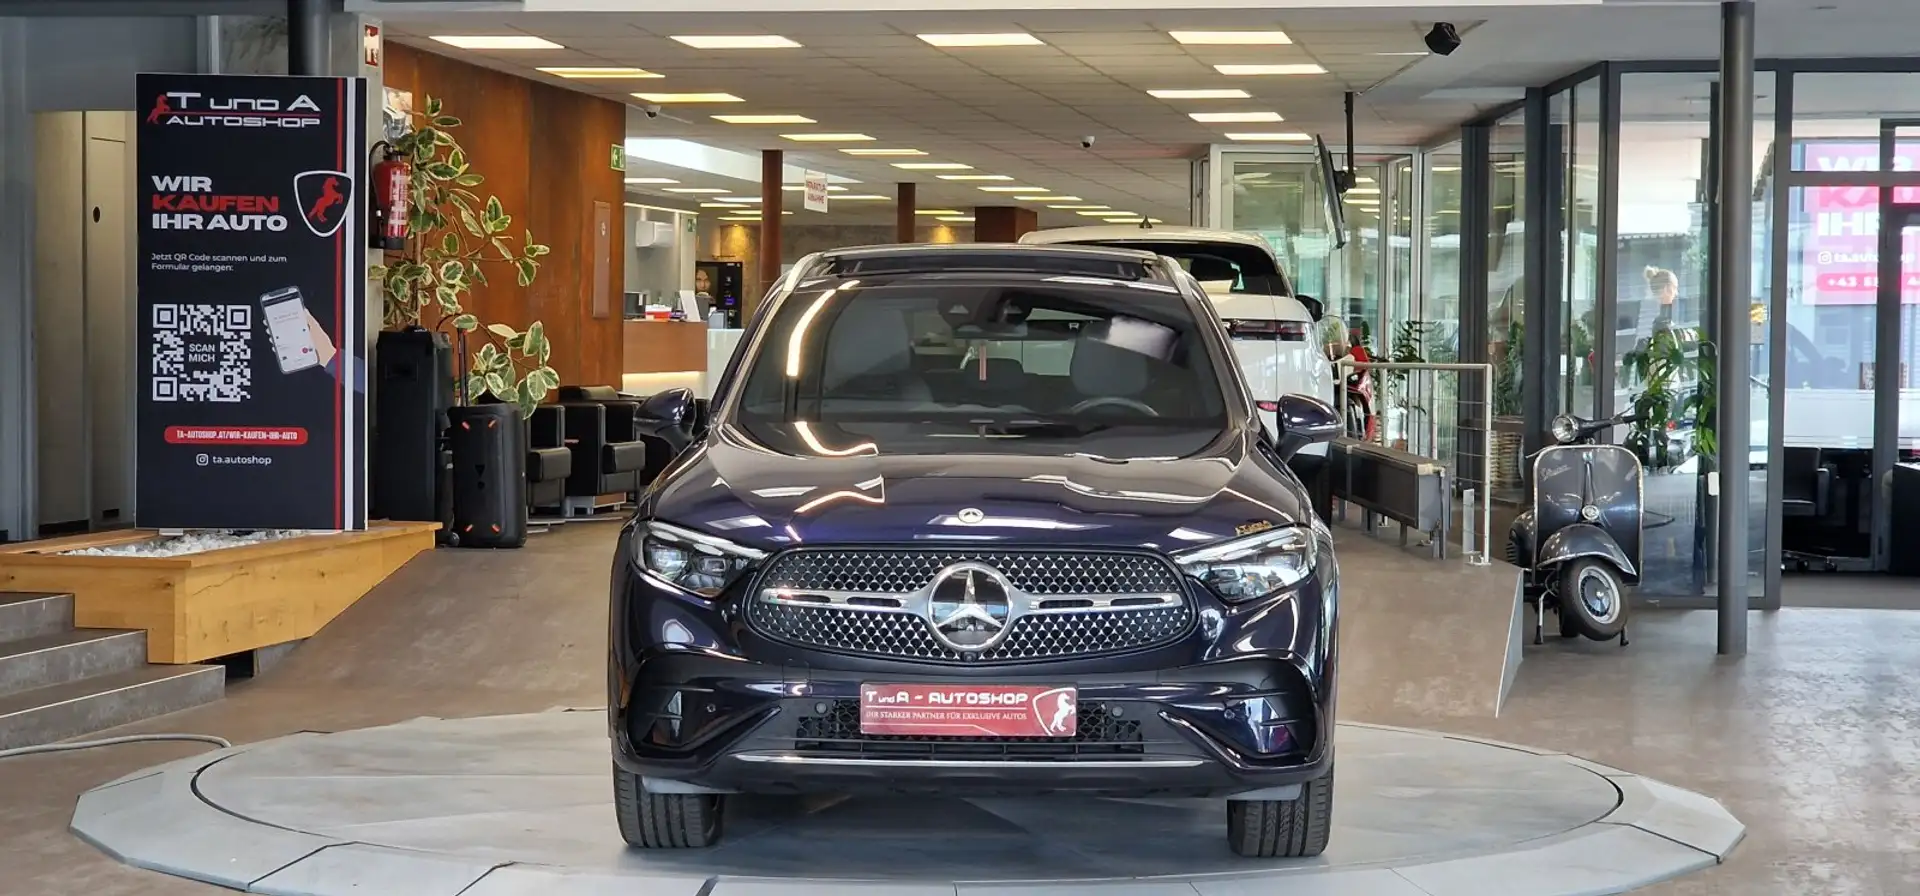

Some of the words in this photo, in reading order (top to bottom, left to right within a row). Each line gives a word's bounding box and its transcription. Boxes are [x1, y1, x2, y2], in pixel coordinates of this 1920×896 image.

[166, 92, 201, 109] T
[287, 94, 321, 112] A
[166, 116, 320, 127] AUTOSHOP
[152, 176, 212, 192] WIR
[152, 195, 279, 212] KAUFEN
[152, 213, 204, 230] IHR
[207, 214, 288, 231] AUTO
[151, 252, 172, 261] Jetzt
[174, 252, 188, 262] QR
[188, 253, 211, 262] Code
[212, 254, 248, 262] scannen
[250, 254, 267, 263] und
[268, 255, 287, 264] zum
[151, 262, 190, 271] Formular
[192, 263, 234, 273] gelangen:
[188, 343, 216, 353] SCAN
[188, 353, 216, 363] MICH
[212, 456, 272, 466] ta.autoshop
[865, 691, 877, 703] T
[896, 692, 910, 704] A
[928, 692, 1029, 705] AUTOSHOP
[912, 712, 946, 720] PARTNER
[946, 712, 962, 720] FÜR
[963, 712, 1001, 720] EXKLUSIVE
